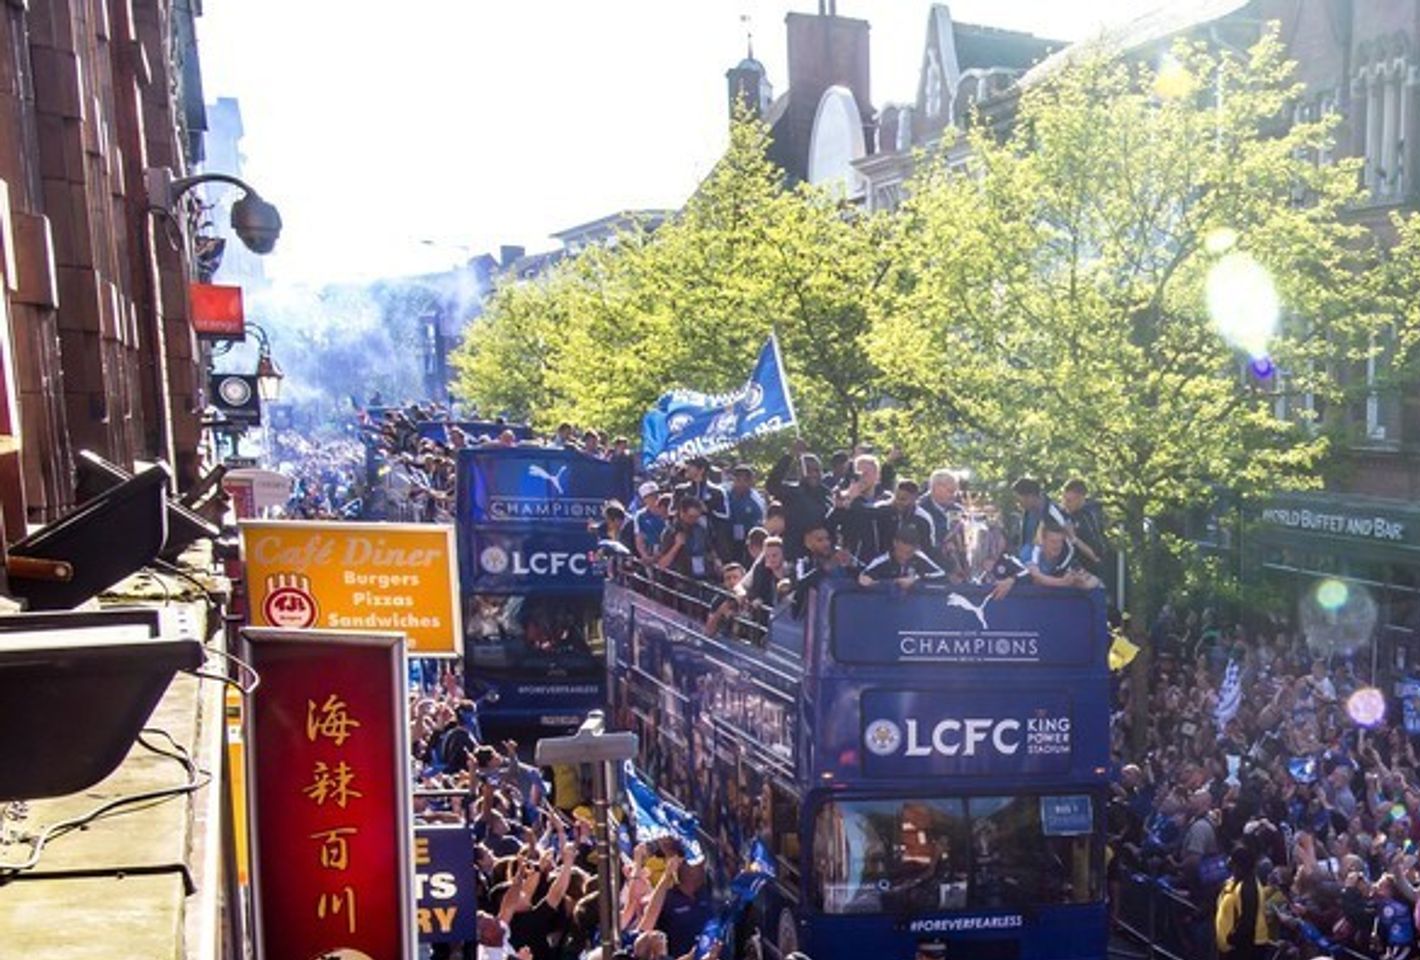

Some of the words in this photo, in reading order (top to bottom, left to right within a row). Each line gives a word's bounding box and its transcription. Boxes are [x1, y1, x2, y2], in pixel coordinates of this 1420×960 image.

[1301, 509, 1346, 533] BUFFET
[1346, 517, 1374, 536] AND
[1374, 517, 1404, 540] BAR
[256, 533, 336, 571] Café
[343, 538, 441, 566] Diner
[512, 552, 588, 575] LCFC
[344, 570, 420, 588] Burgers
[353, 592, 414, 606] Pizzas
[328, 612, 441, 628] Sandwiches
[900, 637, 1039, 655] CHAMPIONS
[1027, 718, 1071, 732] KING
[904, 718, 1021, 756] LCFC
[1027, 733, 1070, 744] POWER
[303, 695, 363, 935] 海辣百川
[909, 914, 1023, 932] #FOREVERFEARLESS
